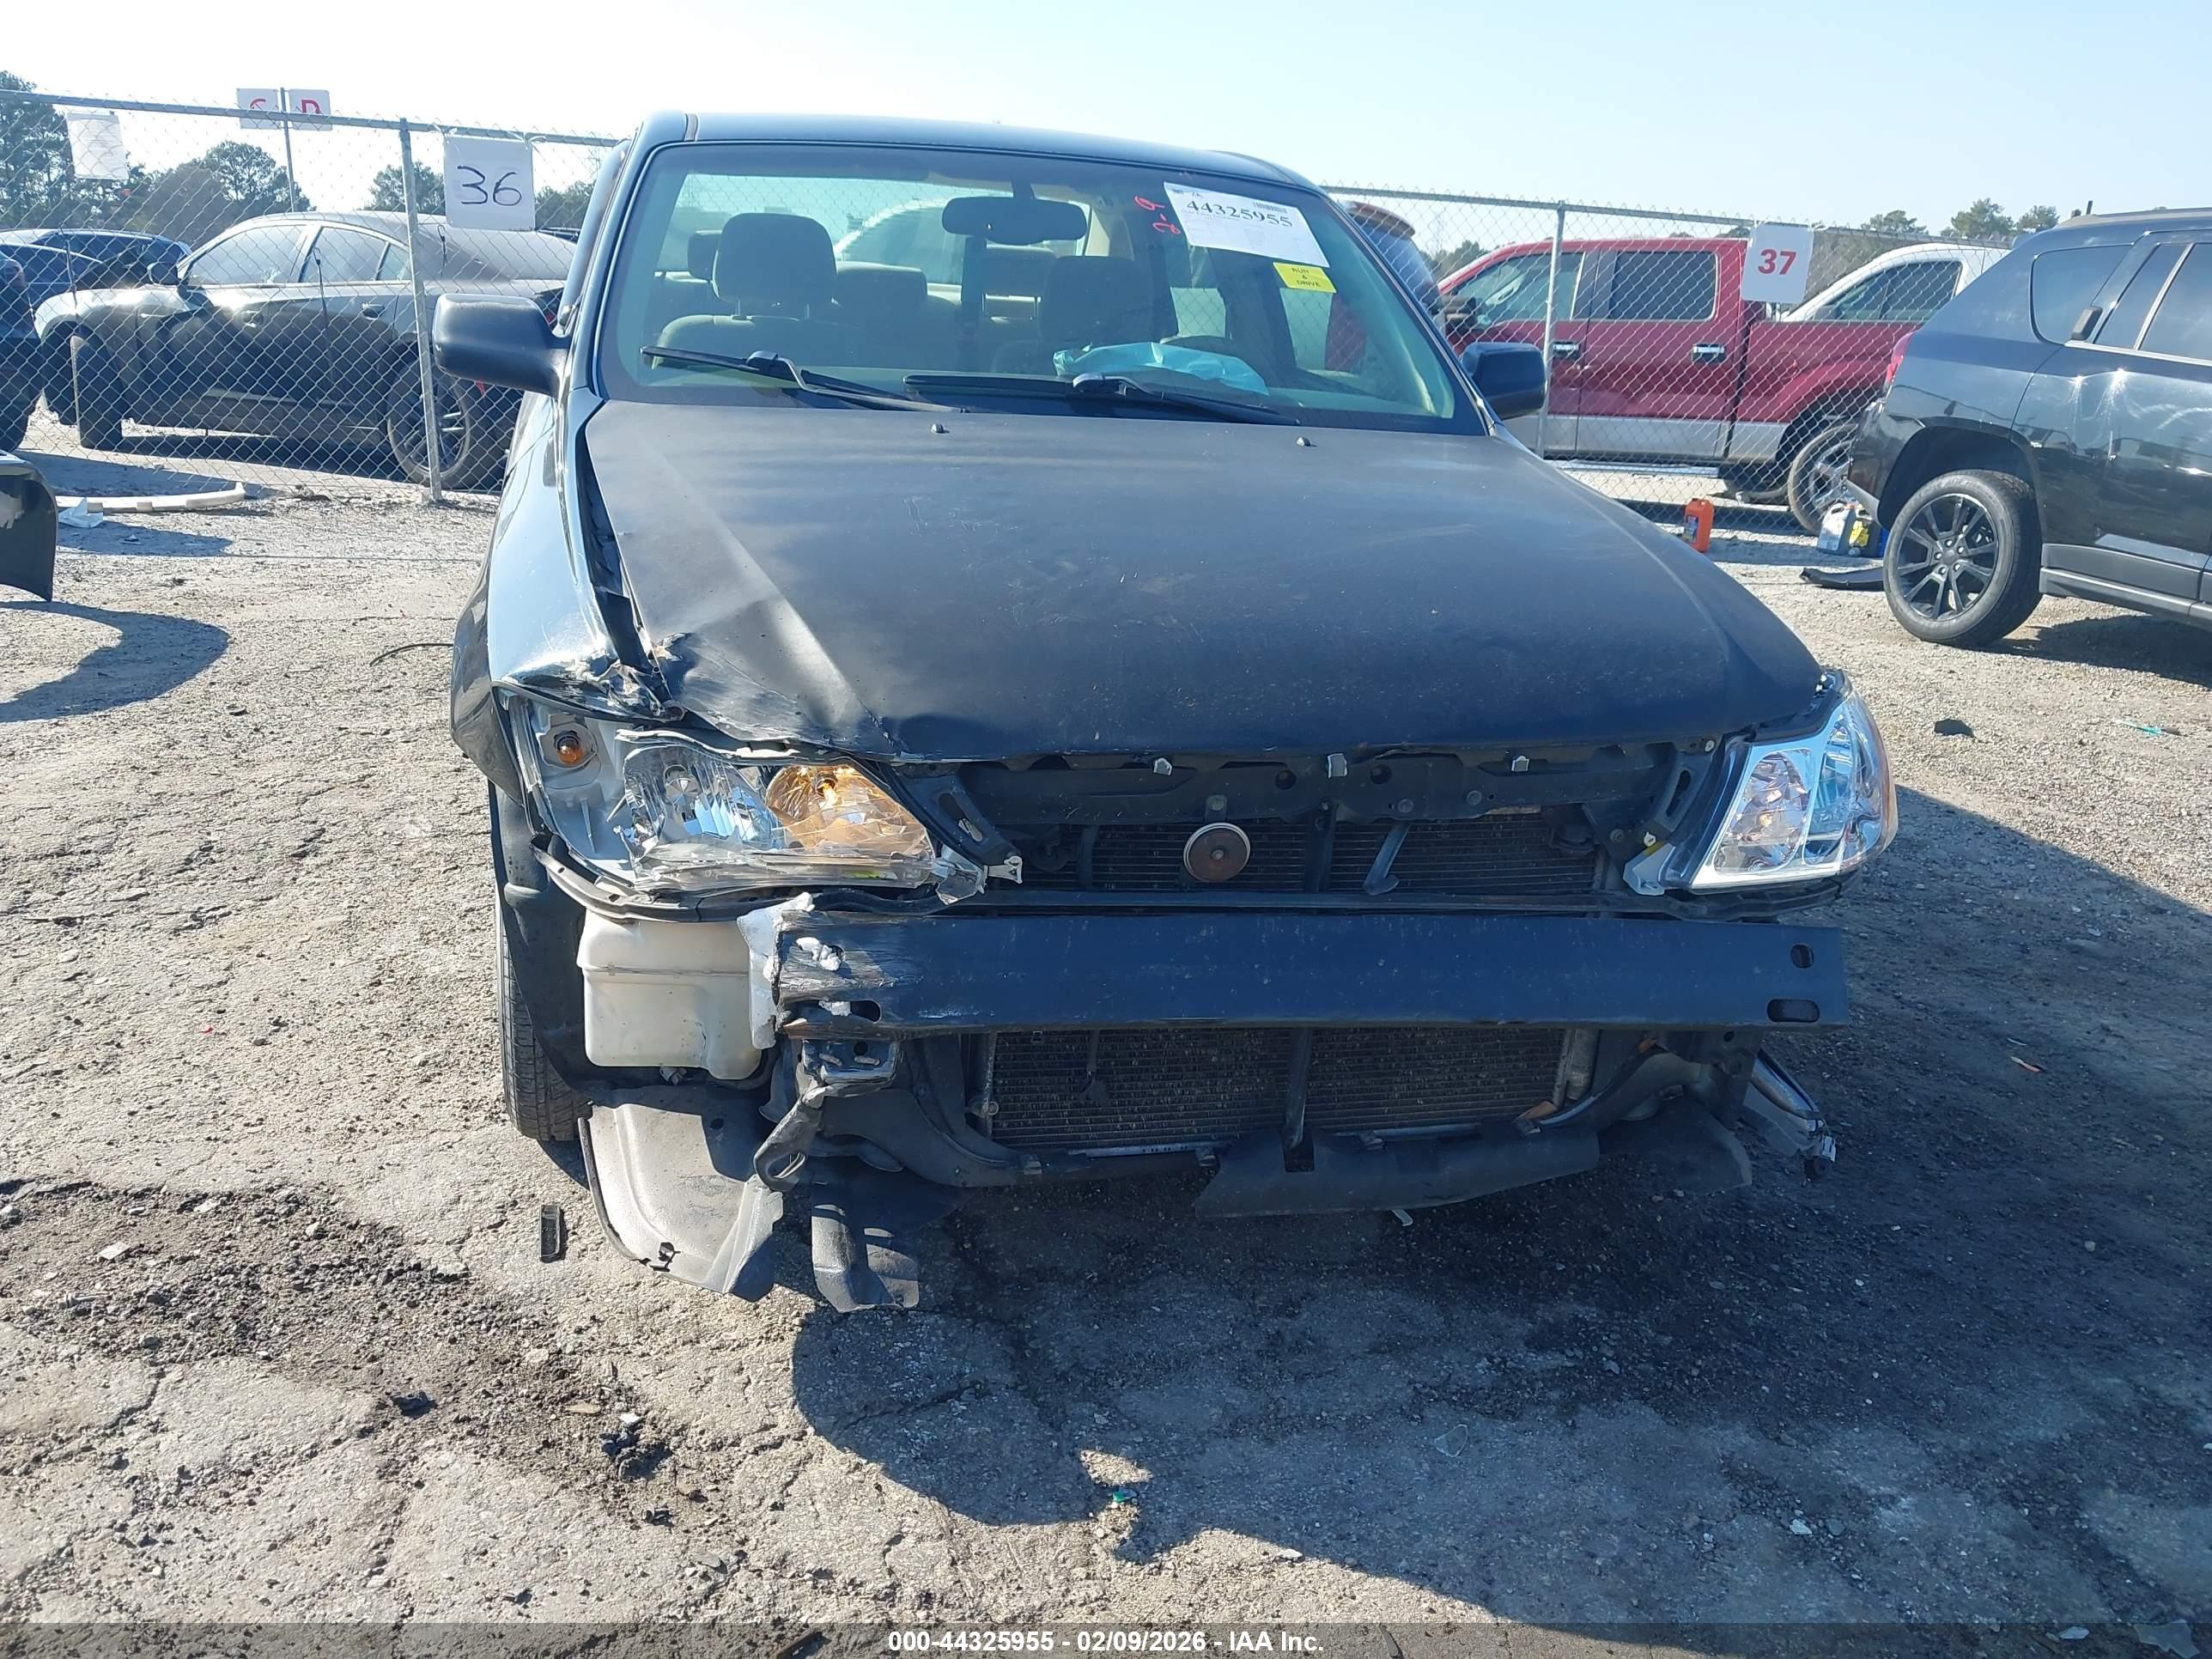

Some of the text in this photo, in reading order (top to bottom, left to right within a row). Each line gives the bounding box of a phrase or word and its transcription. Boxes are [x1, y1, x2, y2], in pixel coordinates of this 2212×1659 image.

[457, 165, 522, 206] 36
[1187, 200, 1292, 228] 44325955
[1758, 248, 1796, 275] 37
